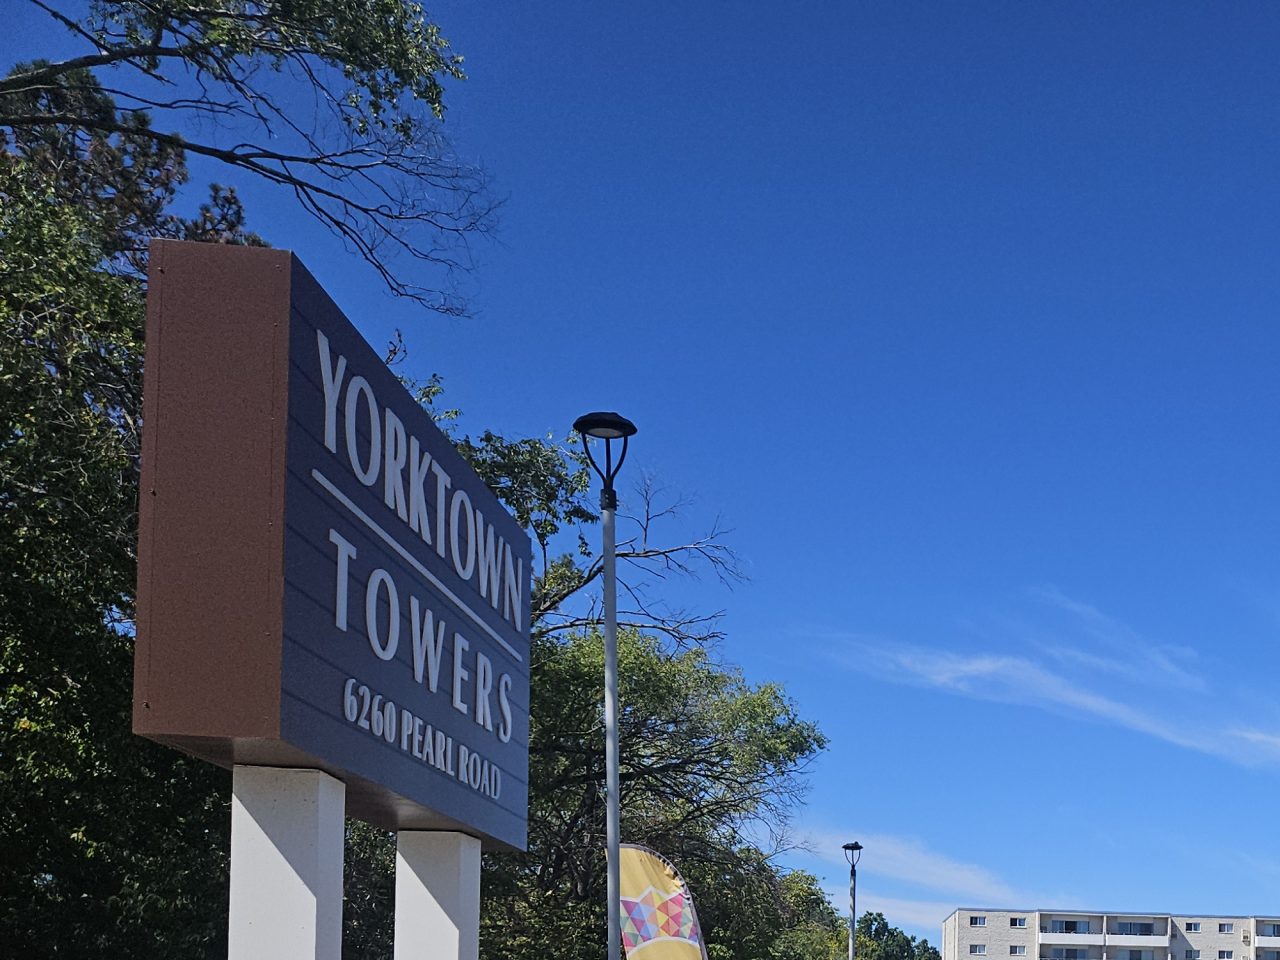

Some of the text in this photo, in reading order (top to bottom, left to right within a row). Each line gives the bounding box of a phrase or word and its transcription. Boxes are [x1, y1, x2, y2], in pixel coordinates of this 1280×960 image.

[316, 329, 523, 633] YORKTOWN
[328, 528, 513, 744] TOWERS
[343, 678, 502, 801] 6260 PEARL ROAD
